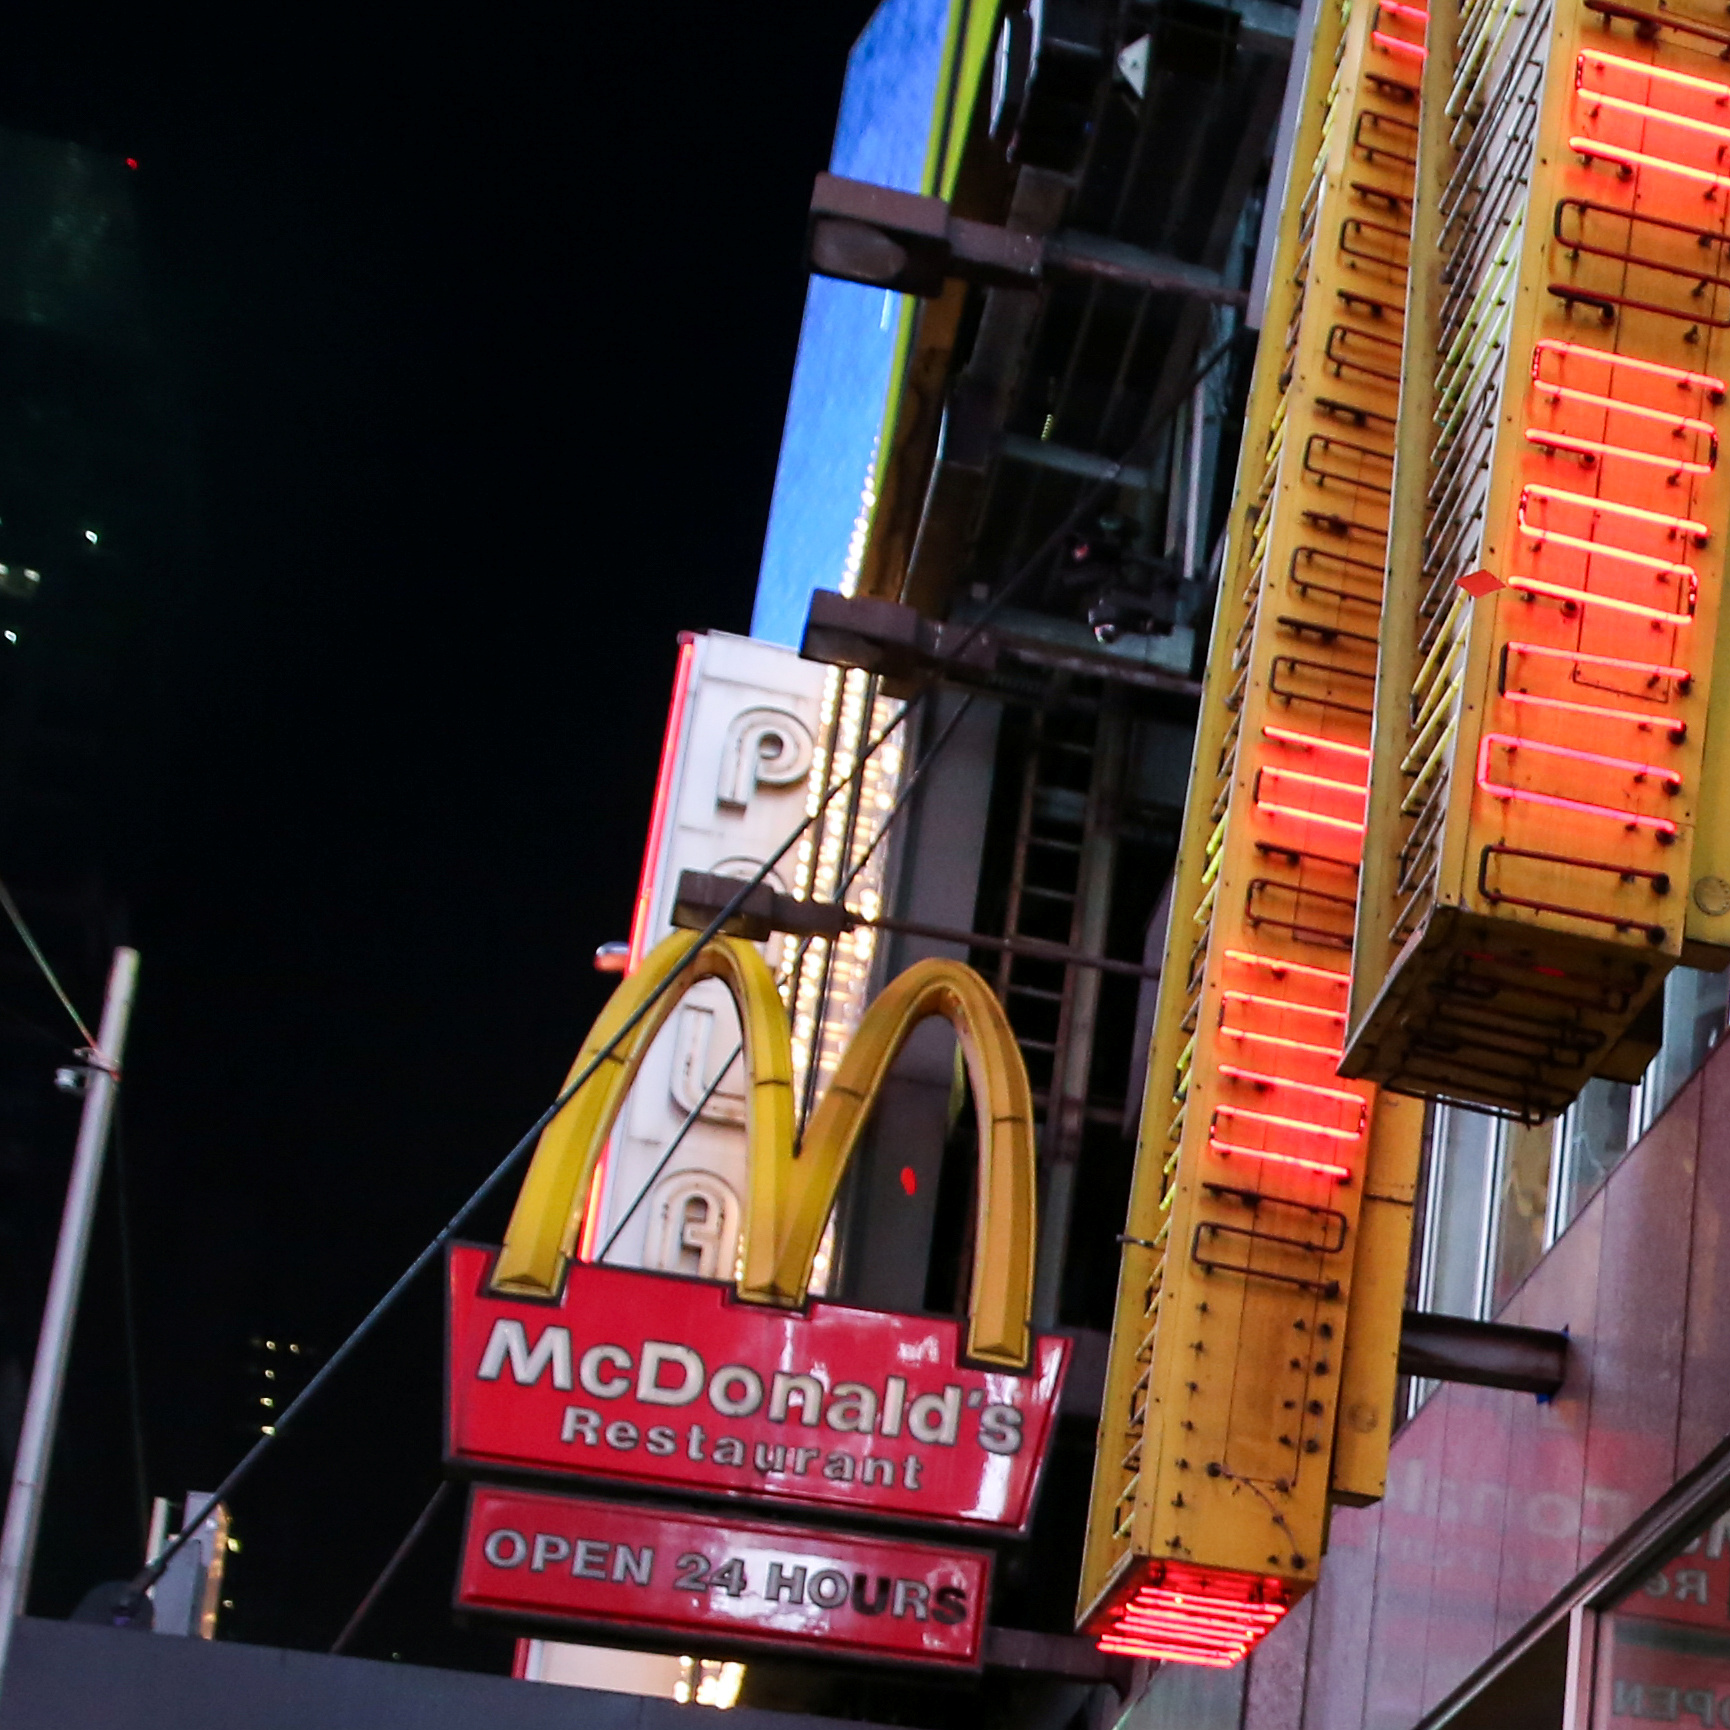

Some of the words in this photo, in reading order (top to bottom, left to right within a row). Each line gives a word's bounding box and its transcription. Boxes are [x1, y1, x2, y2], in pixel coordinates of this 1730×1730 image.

[477, 1319, 1025, 1456] McDonald's
[561, 1406, 922, 1490] Restaurant
[484, 1528, 654, 1586] OPEN
[674, 1552, 747, 1598] 24
[765, 1562, 968, 1625] HOURS
